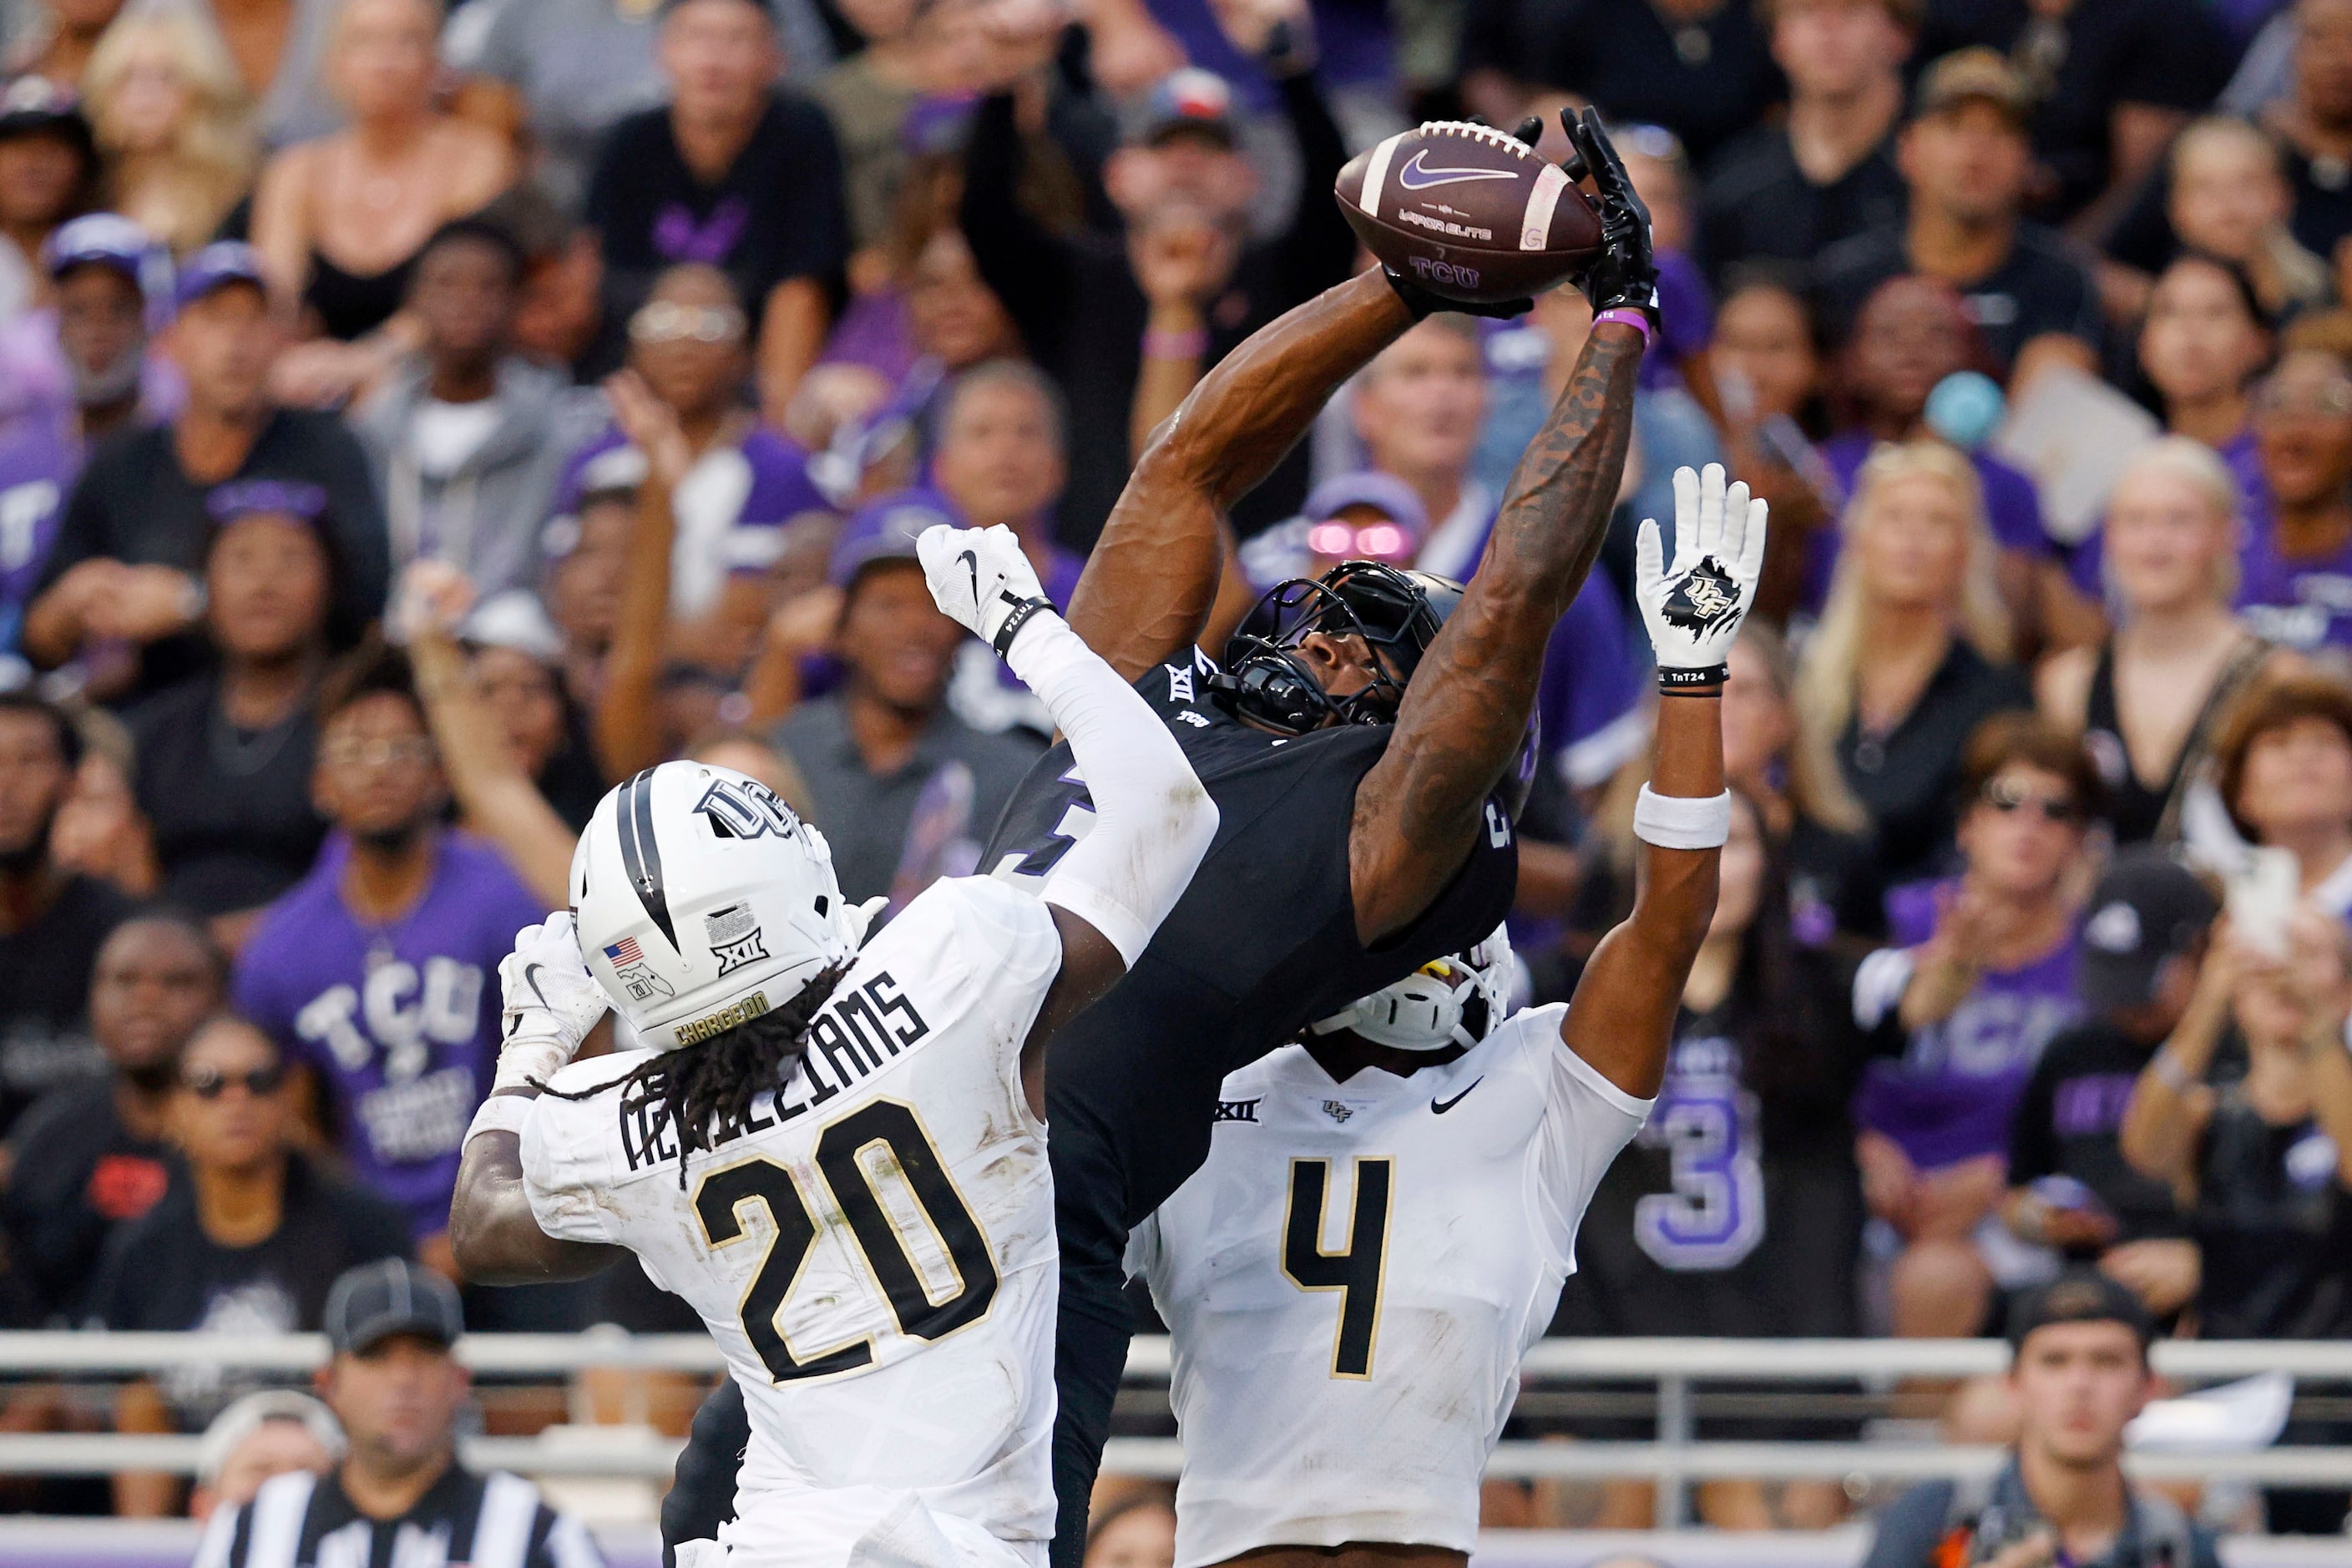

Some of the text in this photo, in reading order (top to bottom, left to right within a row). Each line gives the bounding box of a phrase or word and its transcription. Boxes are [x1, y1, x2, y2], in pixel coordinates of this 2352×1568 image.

[1445, 222, 1493, 241] ELITE
[1409, 255, 1480, 289] TCU
[1684, 575, 1733, 620] UCF
[1004, 603, 1034, 633] TnT24
[1672, 672, 1705, 682] TnT24
[632, 984, 645, 997] 20
[295, 953, 484, 1071] TCU
[1323, 1100, 1353, 1123] UCF
[1633, 1072, 1767, 1271] 3
[689, 1093, 1002, 1389] 20
[1279, 1155, 1397, 1382] 4
